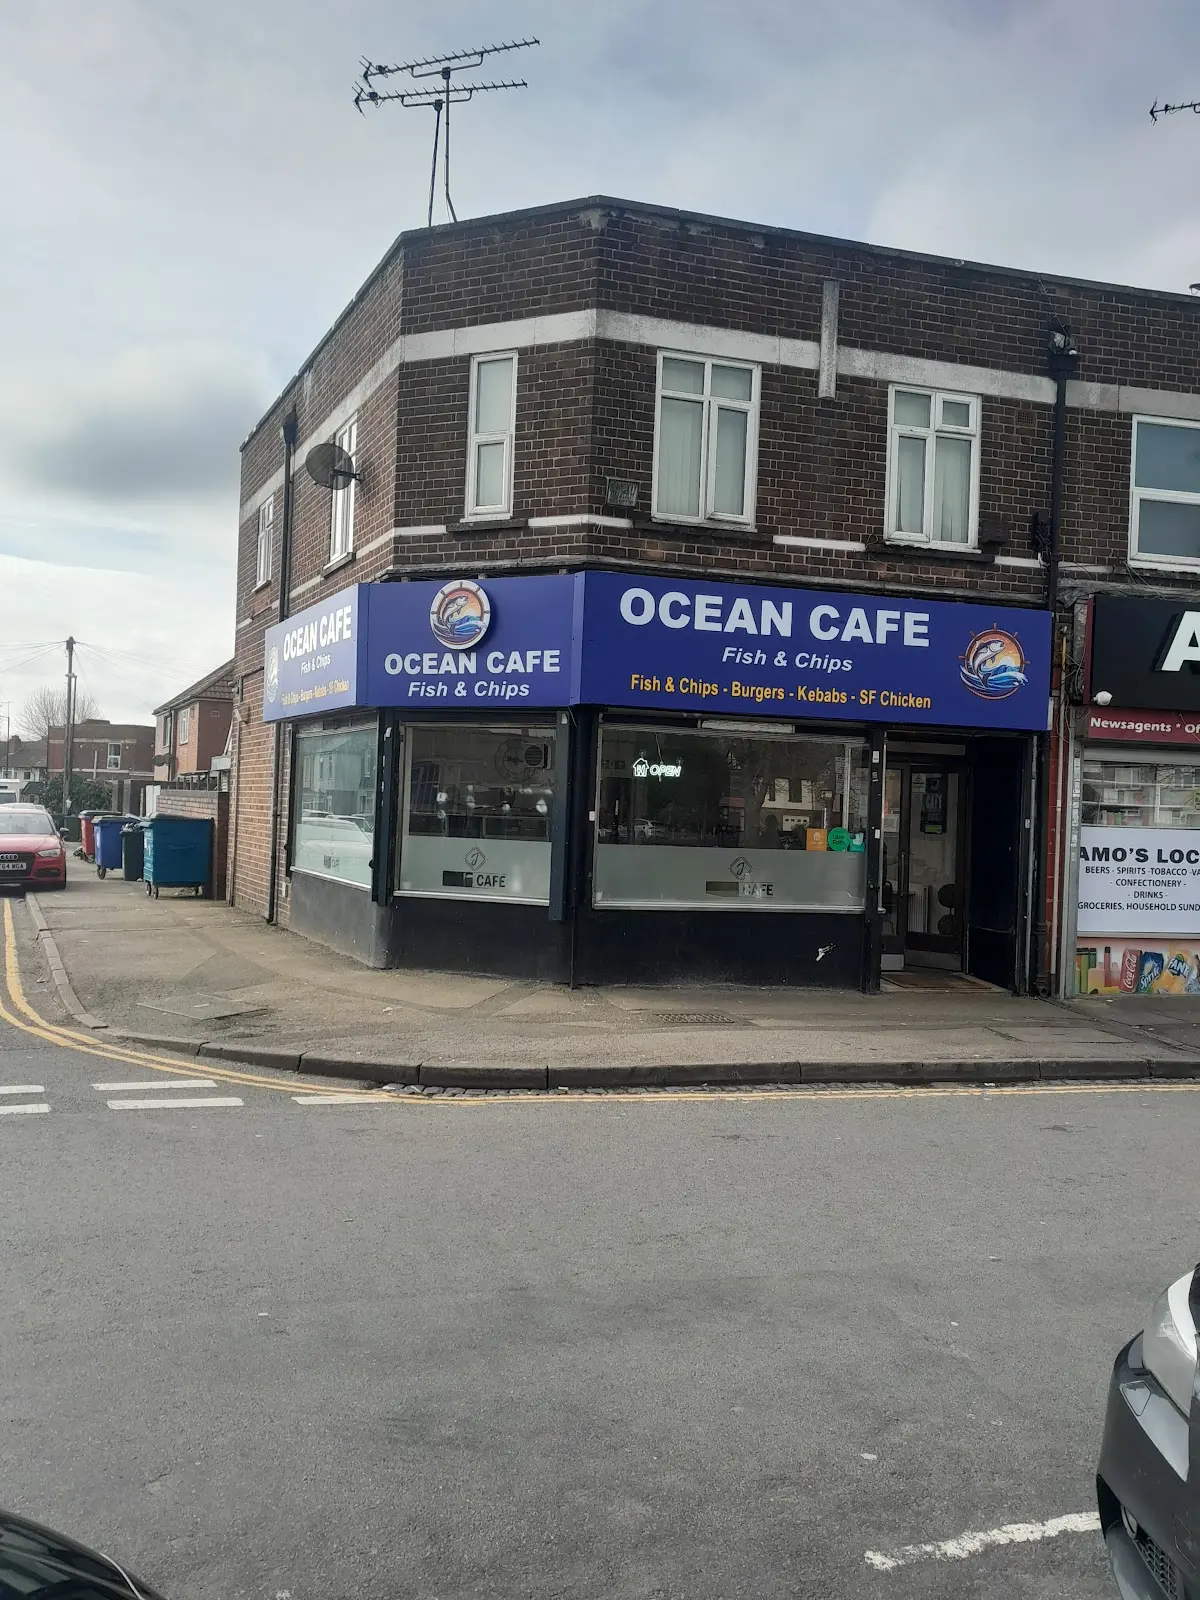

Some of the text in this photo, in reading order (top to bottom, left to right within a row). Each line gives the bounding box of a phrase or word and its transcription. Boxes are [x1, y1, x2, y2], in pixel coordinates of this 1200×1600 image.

[621, 588, 930, 647] OCEAN CAFE
[284, 605, 352, 661] OCEAN CAFE
[384, 650, 560, 675] OCEAN CAFE
[722, 646, 853, 673] Fish & Chips
[408, 680, 530, 700] Fish & Chips
[632, 674, 661, 692] Fish
[664, 676, 675, 693] &
[680, 678, 719, 698] Chips
[732, 682, 785, 703] Burgers
[797, 686, 848, 704] Kebabs
[860, 690, 877, 705] SF
[880, 691, 931, 709] Chicken
[1090, 717, 1172, 733] Newsagents
[649, 764, 681, 778] OPEN
[1080, 846, 1200, 865] AMO'S LOC
[1085, 866, 1110, 874] BEERS
[1116, 867, 1146, 875] SPIRITS
[476, 874, 506, 888] CAFE
[1115, 879, 1182, 887] CONFECTIONERY
[1133, 890, 1164, 899] DRINKS
[1077, 901, 1125, 910] GROCERIES,
[1126, 902, 1177, 911] HOUSEHOLD
